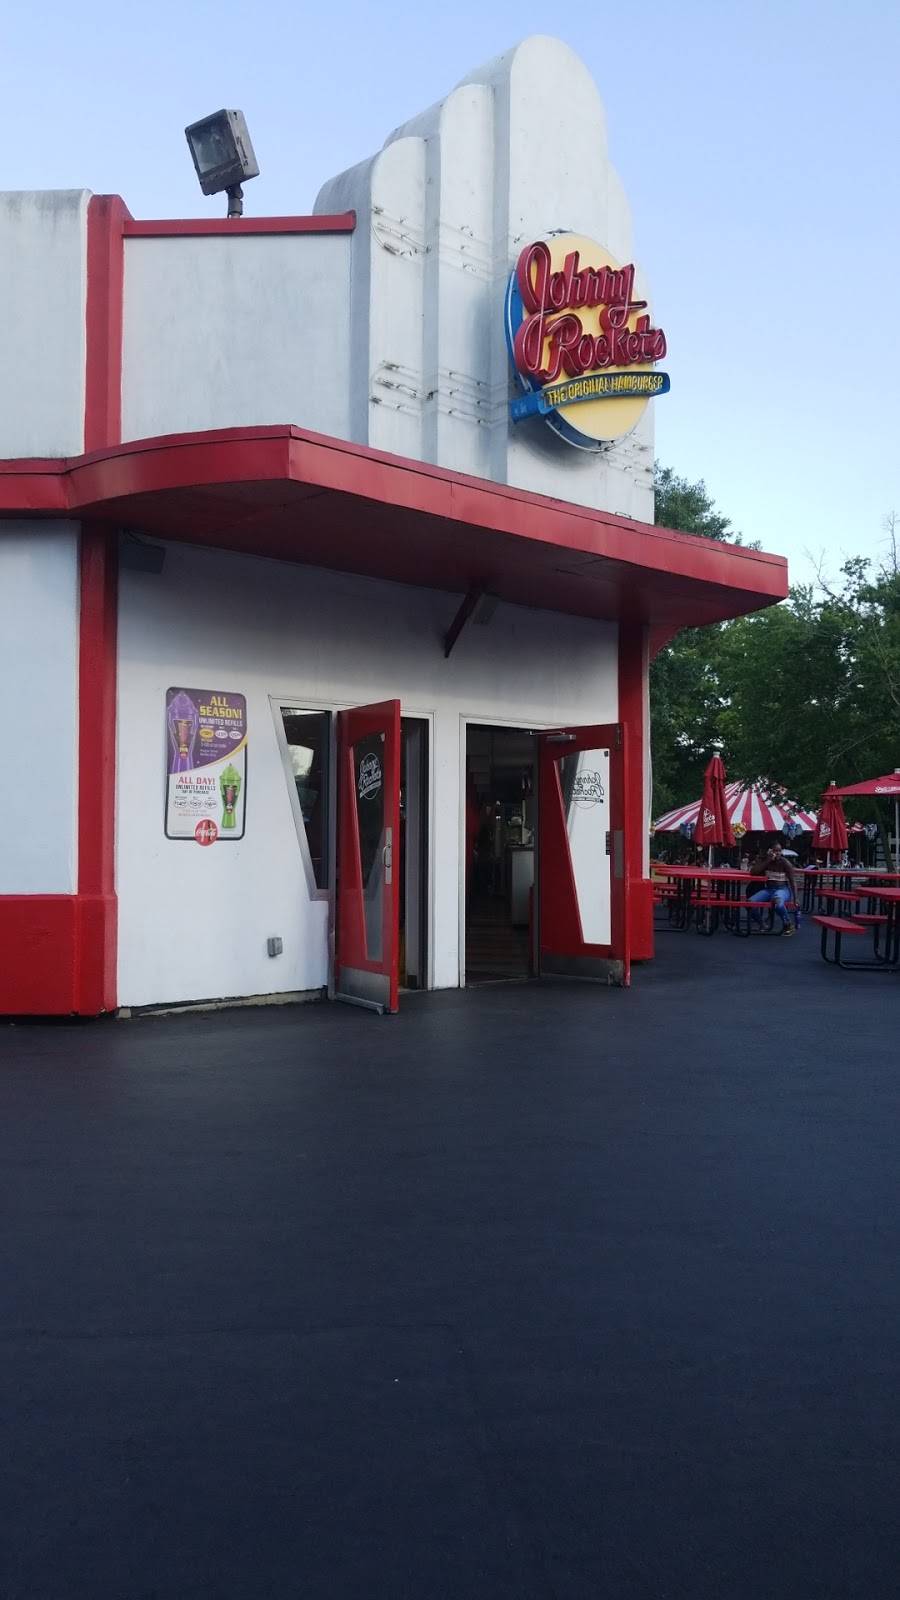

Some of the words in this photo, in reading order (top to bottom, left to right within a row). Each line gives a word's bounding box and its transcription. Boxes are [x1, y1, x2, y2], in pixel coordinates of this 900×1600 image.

[516, 241, 647, 328] Johnny
[527, 313, 667, 383] Rockets
[548, 386, 568, 405] THE
[568, 377, 609, 400] ORIGINAL
[610, 374, 664, 393] HAMBURGER
[210, 695, 229, 707] ALL
[199, 705, 243, 719] SEASON!
[199, 717, 225, 726] UNLIMITED
[178, 776, 193, 785] ALL
[196, 777, 216, 785] DAY!
